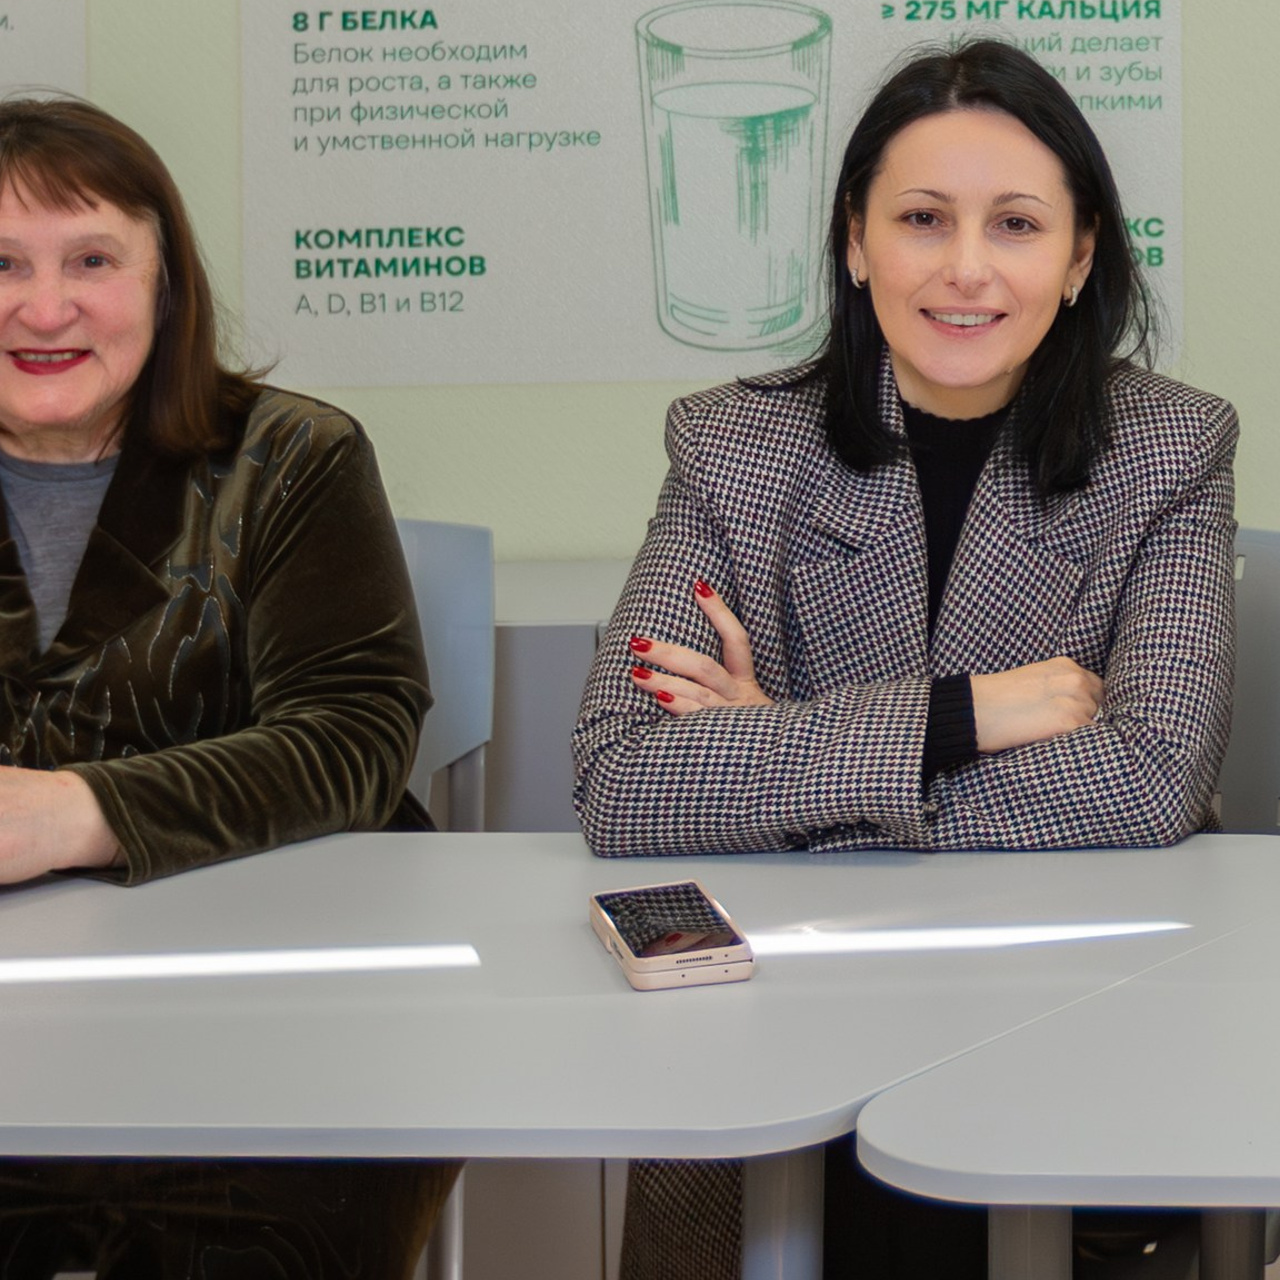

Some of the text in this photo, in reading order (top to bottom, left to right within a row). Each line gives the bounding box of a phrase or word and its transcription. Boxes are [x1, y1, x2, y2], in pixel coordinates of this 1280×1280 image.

[290, 7, 439, 34] 8 Г БЕЛКА
[293, 40, 528, 65] Белок необходим
[1071, 35, 1164, 55] делает
[291, 72, 538, 97] для роста, а также
[1075, 65, 1091, 81] и
[1099, 60, 1163, 87] зубы
[293, 98, 509, 127] при физической
[1079, 94, 1163, 111] пкими
[293, 128, 602, 156] и умственной нагрузке
[292, 225, 467, 251] КОМПЛЕКС
[293, 253, 488, 281] ВИТАМИНОВ
